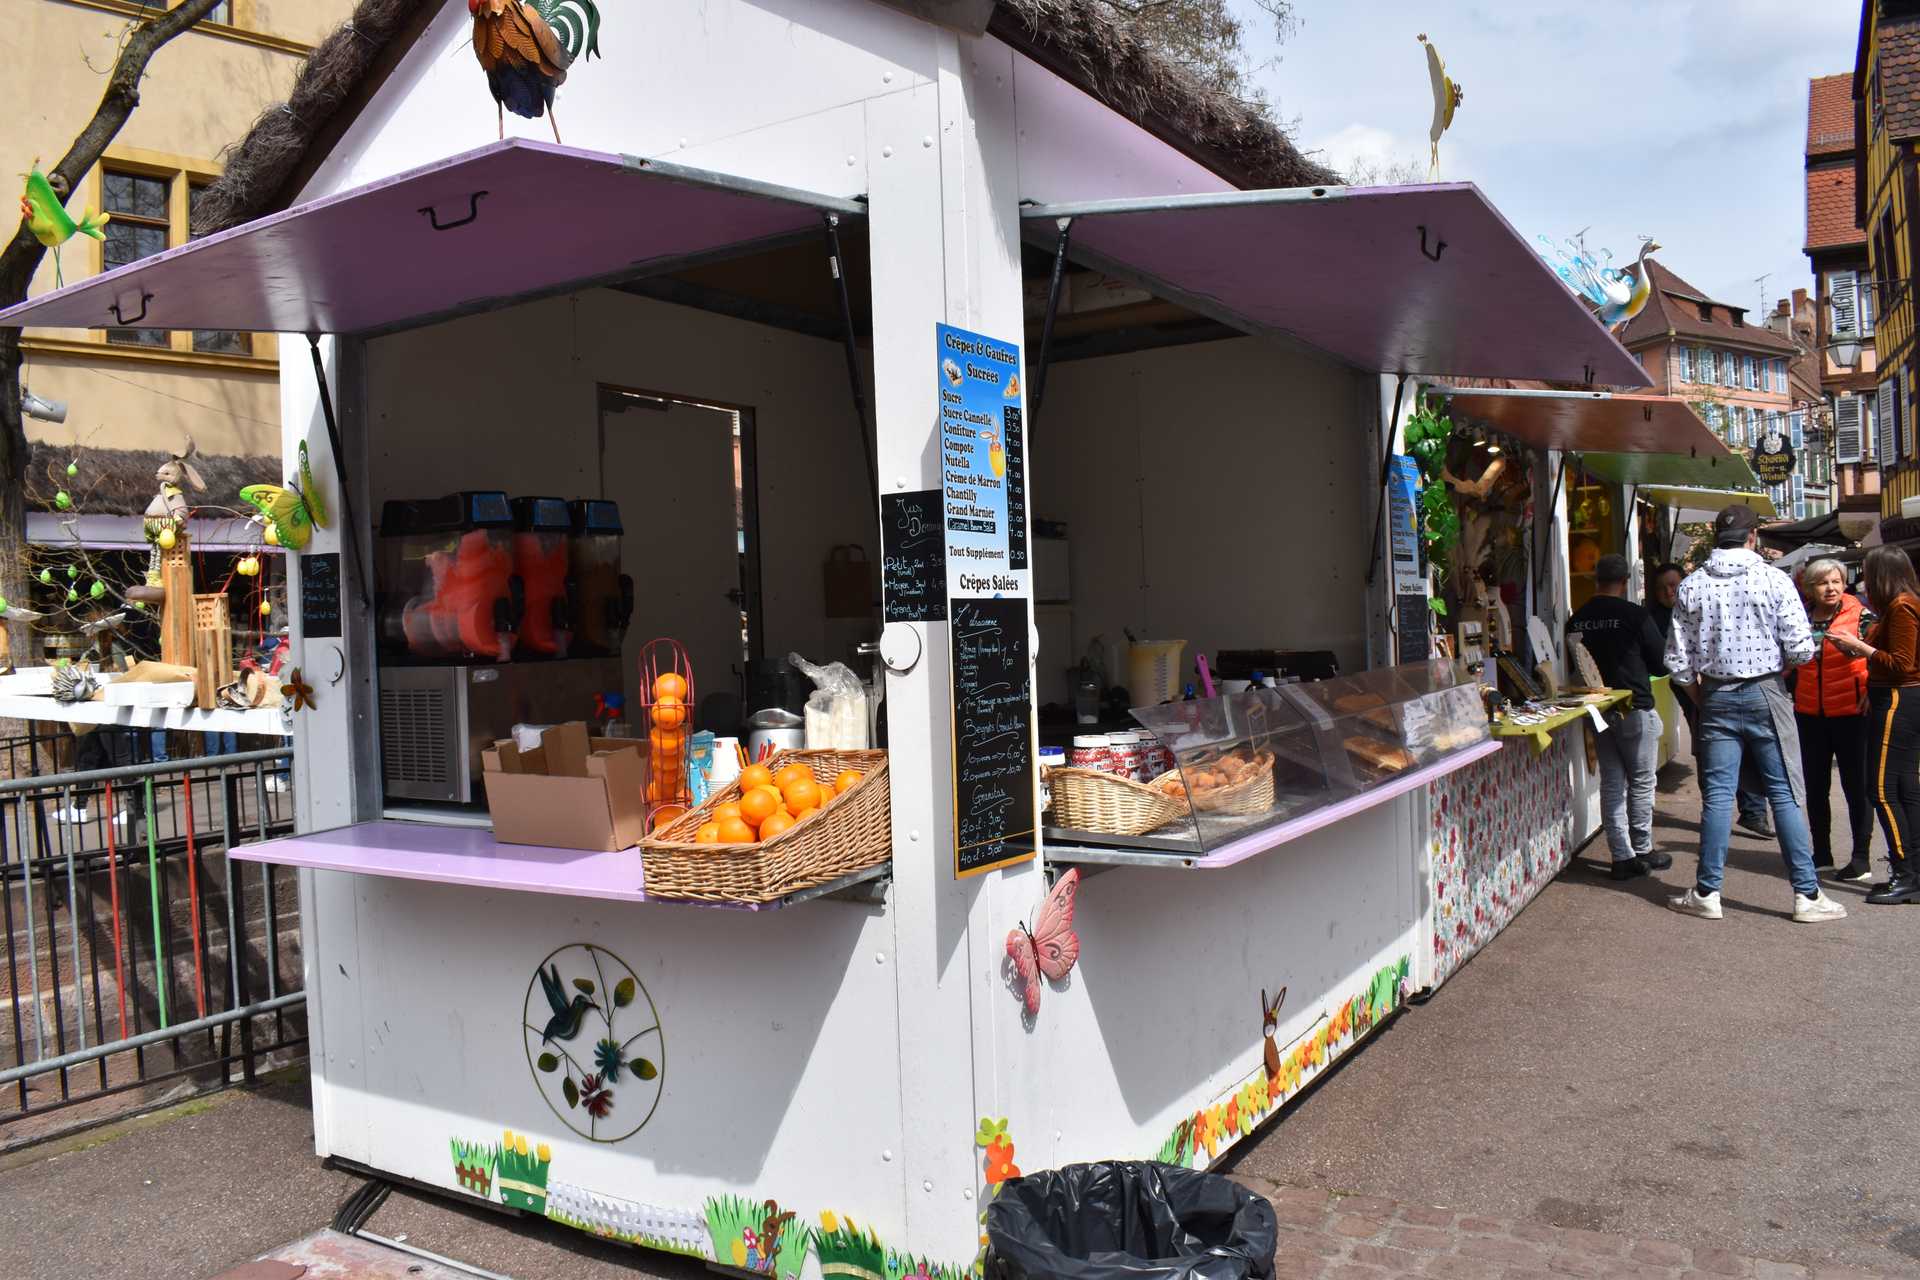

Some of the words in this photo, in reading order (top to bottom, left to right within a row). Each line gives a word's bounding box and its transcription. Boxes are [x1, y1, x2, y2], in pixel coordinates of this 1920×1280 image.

[945, 334, 975, 355] Crêpes
[977, 342, 983, 356] &
[985, 344, 1017, 365] Gaufres
[967, 362, 999, 384] Sucrées
[942, 388, 962, 404] Sucre
[943, 405, 962, 420] Sucre
[963, 409, 992, 426] Cannelle
[943, 421, 976, 438] Confiture
[944, 437, 974, 454] Compote
[945, 452, 970, 469] Nutella
[945, 470, 967, 485] Crème
[968, 474, 976, 486] de
[977, 474, 1001, 489] Marron
[946, 486, 977, 504] Chantilly
[946, 502, 968, 516] Grand
[969, 504, 995, 519] Marnier
[949, 545, 965, 557] Tout
[966, 547, 1004, 560] Supplément
[885, 556, 908, 571] Petit
[960, 573, 990, 593] Crêpes
[992, 574, 1018, 591] Salées
